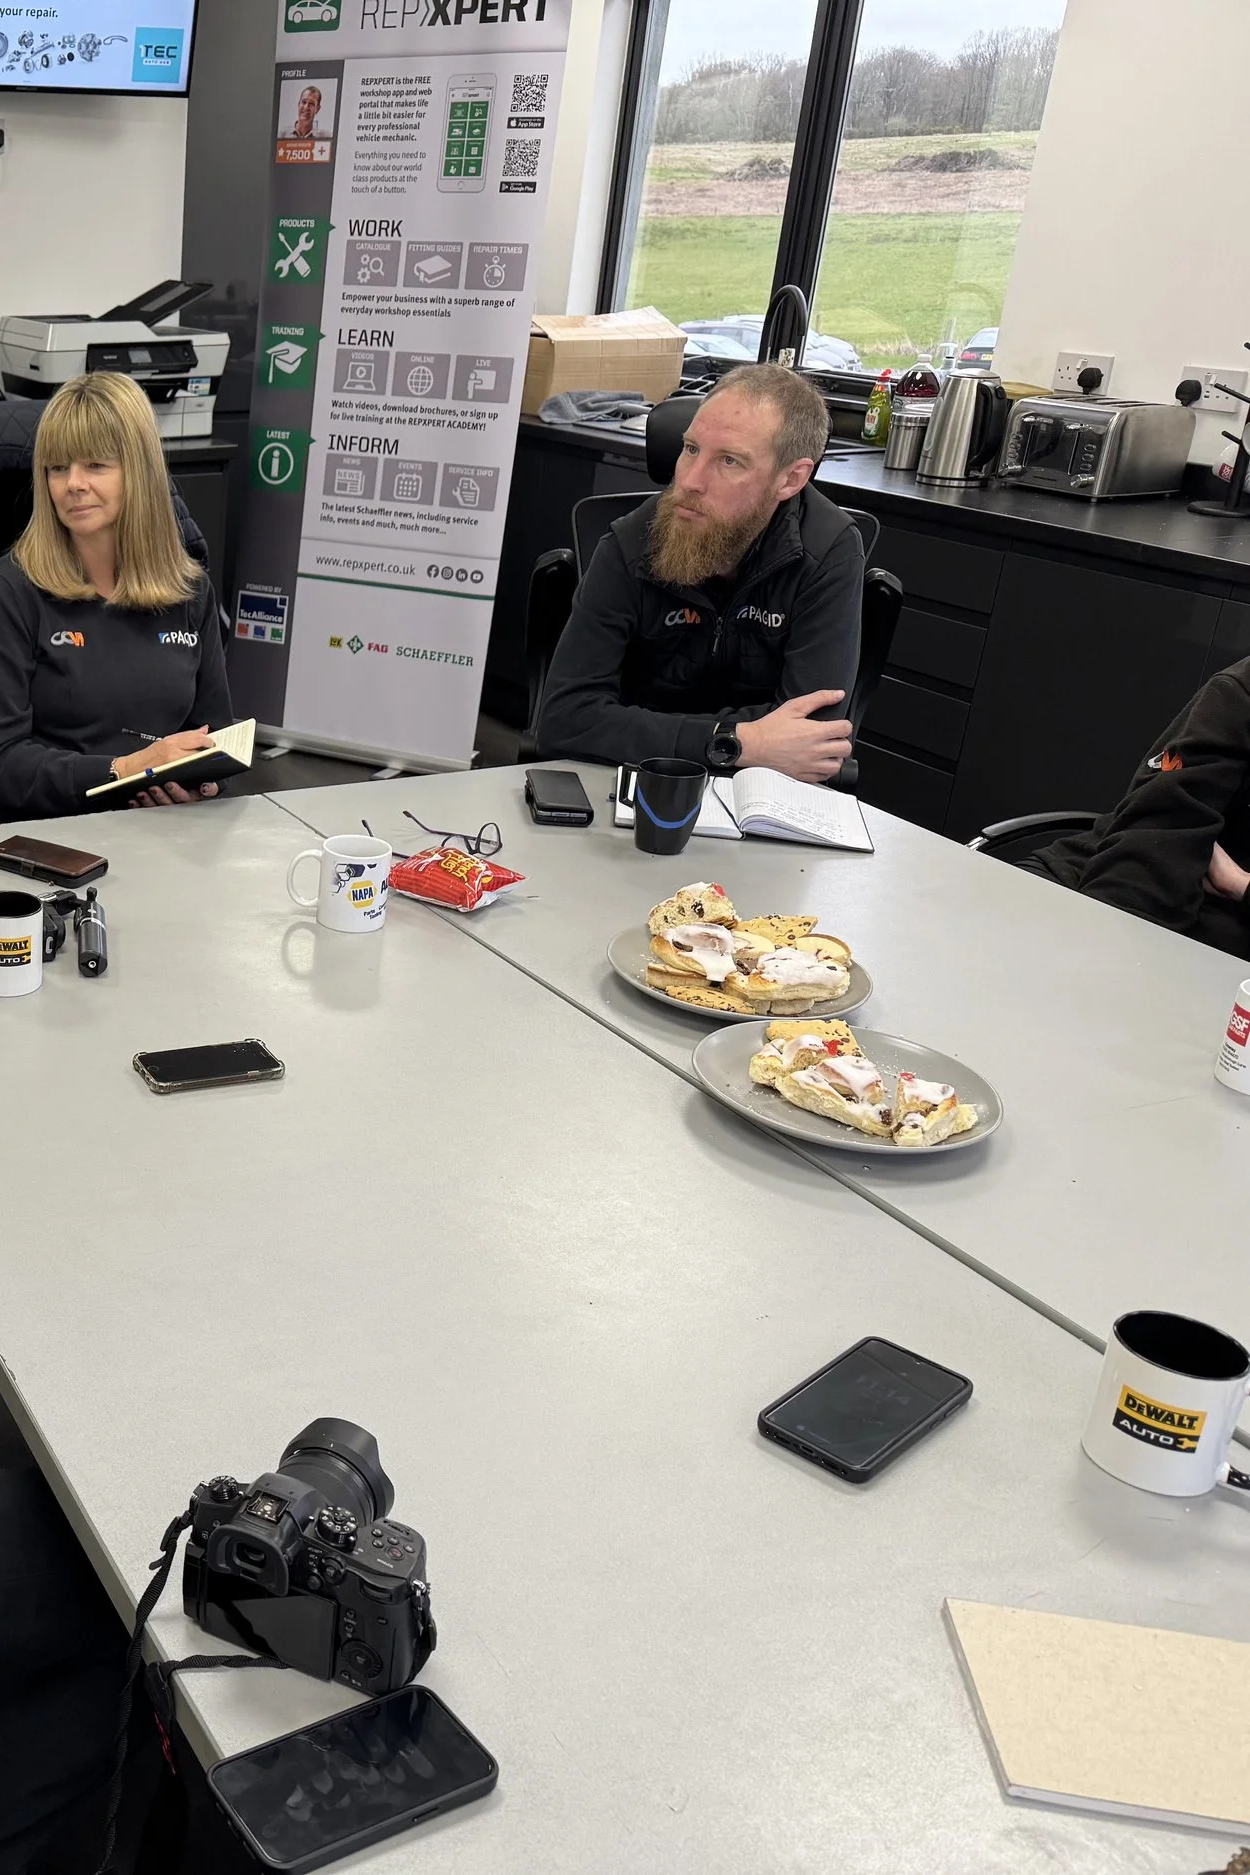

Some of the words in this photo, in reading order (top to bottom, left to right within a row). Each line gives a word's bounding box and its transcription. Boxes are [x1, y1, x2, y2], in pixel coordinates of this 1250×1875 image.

[0, 7, 23, 18] your
[26, 6, 58, 19] repair.
[143, 44, 178, 58] TEC
[281, 69, 307, 77] PROFILE
[361, 77, 395, 86] REPXPERT
[395, 77, 401, 85] is
[403, 76, 413, 85] the
[415, 76, 431, 84] FREE
[360, 89, 391, 98] workshop
[392, 90, 404, 98] app
[405, 87, 417, 96] and
[419, 88, 432, 96] web
[359, 100, 379, 110] portal
[380, 100, 393, 108] that
[395, 99, 416, 108] makes
[417, 99, 429, 107] life
[364, 111, 380, 119] little
[382, 111, 392, 119] bit
[393, 110, 414, 119] easier
[415, 110, 426, 118] for
[357, 124, 376, 132] every
[377, 122, 420, 132] professional
[356, 134, 380, 142] vehicle
[382, 133, 417, 142] mechanic.
[286, 149, 310, 161] 7,500
[354, 151, 387, 160] Everything
[389, 152, 400, 160] you
[401, 150, 418, 159] need
[419, 151, 426, 159] to
[353, 163, 370, 171] know
[404, 163, 422, 171] world
[352, 174, 368, 182] class
[370, 174, 398, 183] products
[351, 185, 369, 193] touch
[371, 185, 378, 193] of
[384, 185, 406, 194] button.
[279, 219, 315, 228] PRODUCTS
[349, 219, 403, 238] WORK
[355, 243, 391, 251] CATALOGUE
[408, 244, 435, 252] FITTING
[436, 244, 461, 253] GUIDES
[500, 246, 523, 254] TIMES
[342, 292, 374, 303] Empower
[376, 295, 393, 304] your
[394, 294, 428, 304] business
[429, 296, 446, 304] with
[454, 297, 479, 306] superb
[481, 300, 505, 309] range
[506, 298, 516, 307] of
[340, 305, 373, 315] everyday
[374, 307, 411, 317] workshop
[412, 308, 451, 318] essentials
[271, 326, 304, 336] TRAINING
[338, 328, 394, 347] LEARN
[351, 352, 374, 360] VIDEOS
[410, 355, 435, 364] ONLINE
[476, 359, 492, 367] LIVE
[331, 400, 353, 409] Watch
[354, 401, 380, 411] videos,
[382, 403, 418, 413] download
[419, 406, 458, 417] brochures,
[470, 410, 486, 419] sign
[488, 412, 498, 420] up
[330, 412, 340, 420] for
[341, 413, 354, 421] live
[355, 414, 383, 425] training
[394, 416, 407, 425] the
[408, 417, 446, 427] REPXPERT
[447, 420, 486, 431] ACADEMY!
[266, 430, 290, 440] LATEST
[327, 434, 400, 455] INFORM
[398, 462, 422, 470] EVENTS
[449, 467, 474, 476] SERVICE
[476, 469, 493, 477] INFO
[321, 502, 333, 511] The
[335, 504, 355, 513] latest
[356, 505, 392, 517] Schaeffler
[393, 510, 415, 520] news,
[416, 511, 451, 524] including
[452, 516, 479, 526] service
[320, 513, 335, 524] info,
[337, 516, 360, 524] events
[361, 518, 374, 527] and
[376, 520, 398, 530] much,
[400, 523, 420, 531] much
[421, 525, 447, 534] more...
[316, 556, 416, 576] www.repxpert.co.uk
[240, 609, 283, 622] TecAlliance
[749, 606, 782, 627] PAGID
[367, 642, 388, 653] FAG
[396, 646, 474, 667] SCHAEFFLER
[352, 887, 373, 902] NAPA
[1230, 1010, 1249, 1032] GSF
[1124, 1392, 1198, 1430] DEWALT
[1119, 1419, 1174, 1445] AUTO
